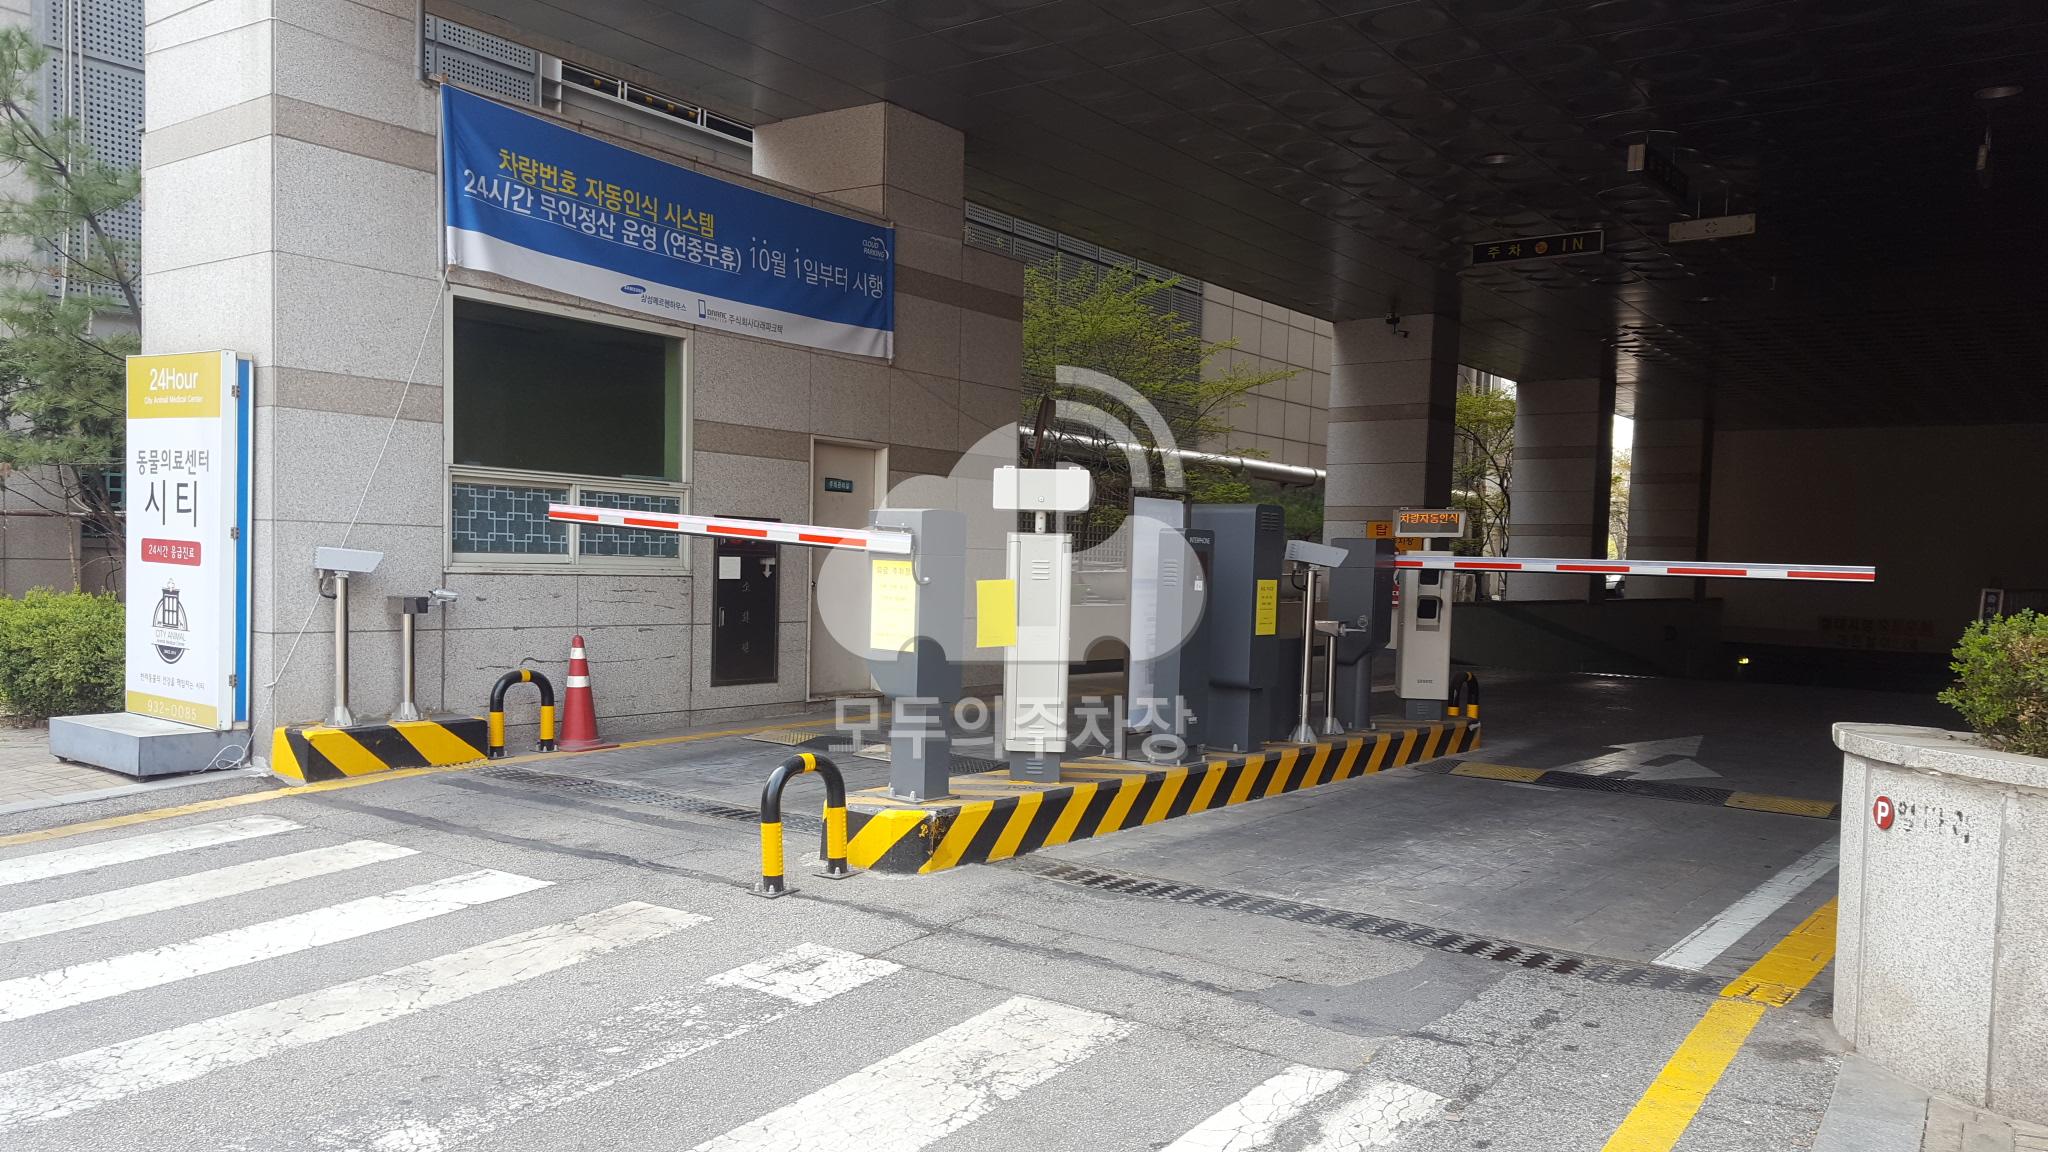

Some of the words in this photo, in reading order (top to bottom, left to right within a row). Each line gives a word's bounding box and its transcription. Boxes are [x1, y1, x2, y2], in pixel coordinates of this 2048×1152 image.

[498, 148, 579, 197] 차량번호
[585, 177, 659, 223] 자동인식
[664, 202, 715, 238] 시스템
[463, 168, 535, 215] 24시간
[540, 193, 617, 240] 무인정산
[621, 218, 657, 252] 운영
[663, 230, 742, 273] (연중무휴)
[749, 244, 787, 279] 10월
[793, 256, 849, 293] 1일부터
[853, 272, 884, 300] 시행
[1562, 236, 1584, 252] IN
[863, 247, 886, 258] PARKING
[624, 285, 644, 294] SAMSUNG
[149, 367, 199, 391] 24Hour
[136, 448, 210, 476] 동물의료센터
[144, 479, 198, 528] 시티
[148, 544, 169, 558] 24시간
[170, 545, 196, 560] 응급진료
[155, 629, 167, 639] CITY
[167, 631, 187, 642] ANIMAL
[147, 698, 197, 720] 932-0085
